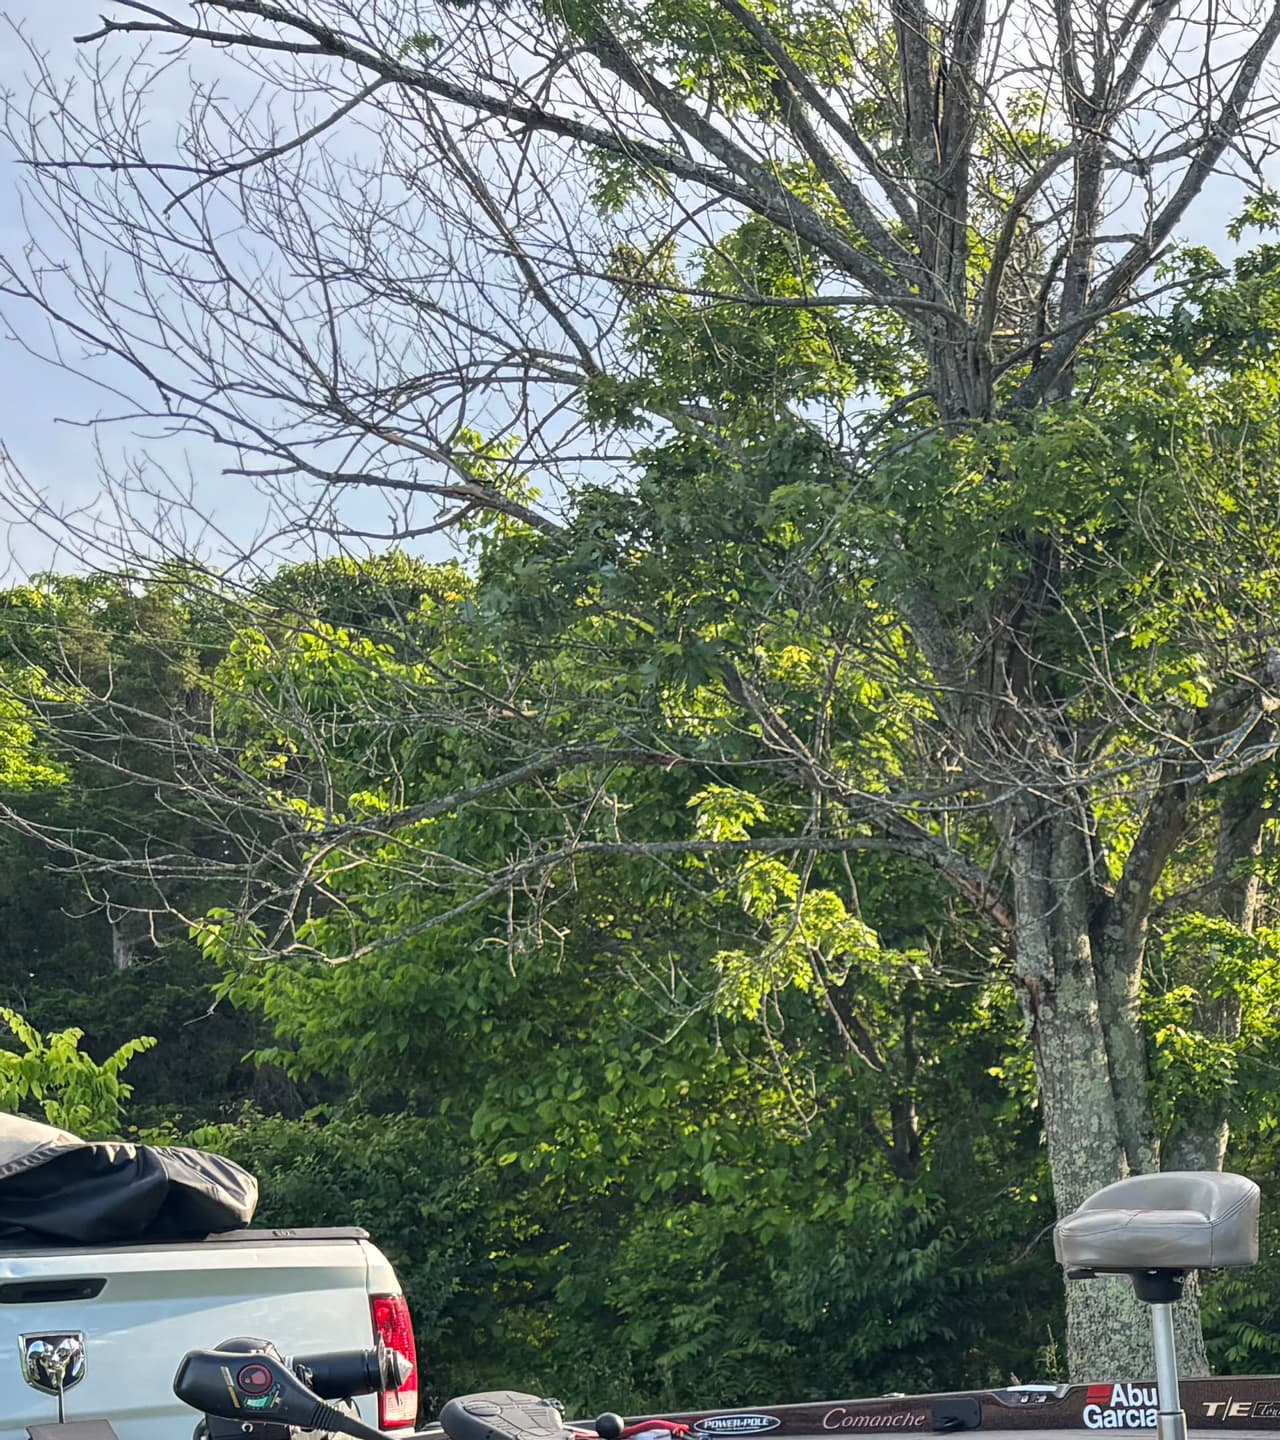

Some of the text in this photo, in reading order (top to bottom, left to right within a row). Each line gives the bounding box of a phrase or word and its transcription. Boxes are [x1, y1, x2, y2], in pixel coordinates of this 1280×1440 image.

[1110, 1383, 1158, 1407] Abu
[703, 1417, 769, 1429] POWER-POLE
[822, 1407, 926, 1430] Comanche
[1083, 1404, 1158, 1429] Garcia
